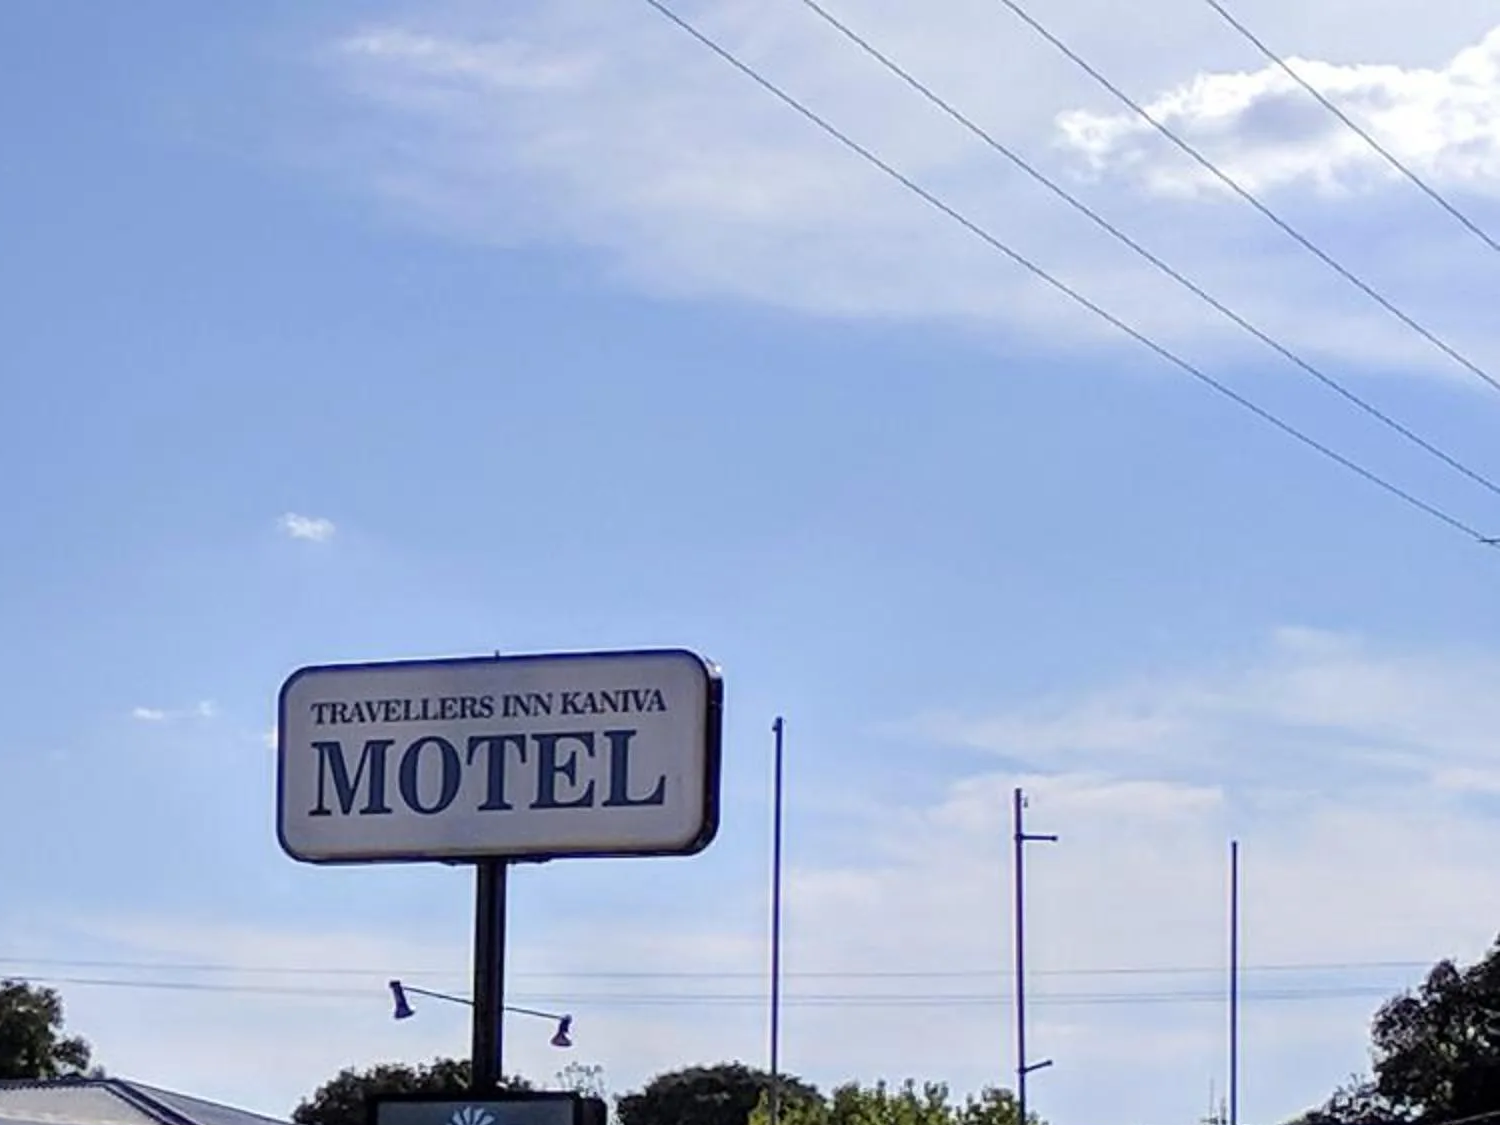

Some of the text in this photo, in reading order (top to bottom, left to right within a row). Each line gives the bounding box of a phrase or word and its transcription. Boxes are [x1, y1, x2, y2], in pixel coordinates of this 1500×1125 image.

[310, 688, 667, 725] TRAVELLERS INN KANIVA
[308, 729, 667, 817] MOTEL
